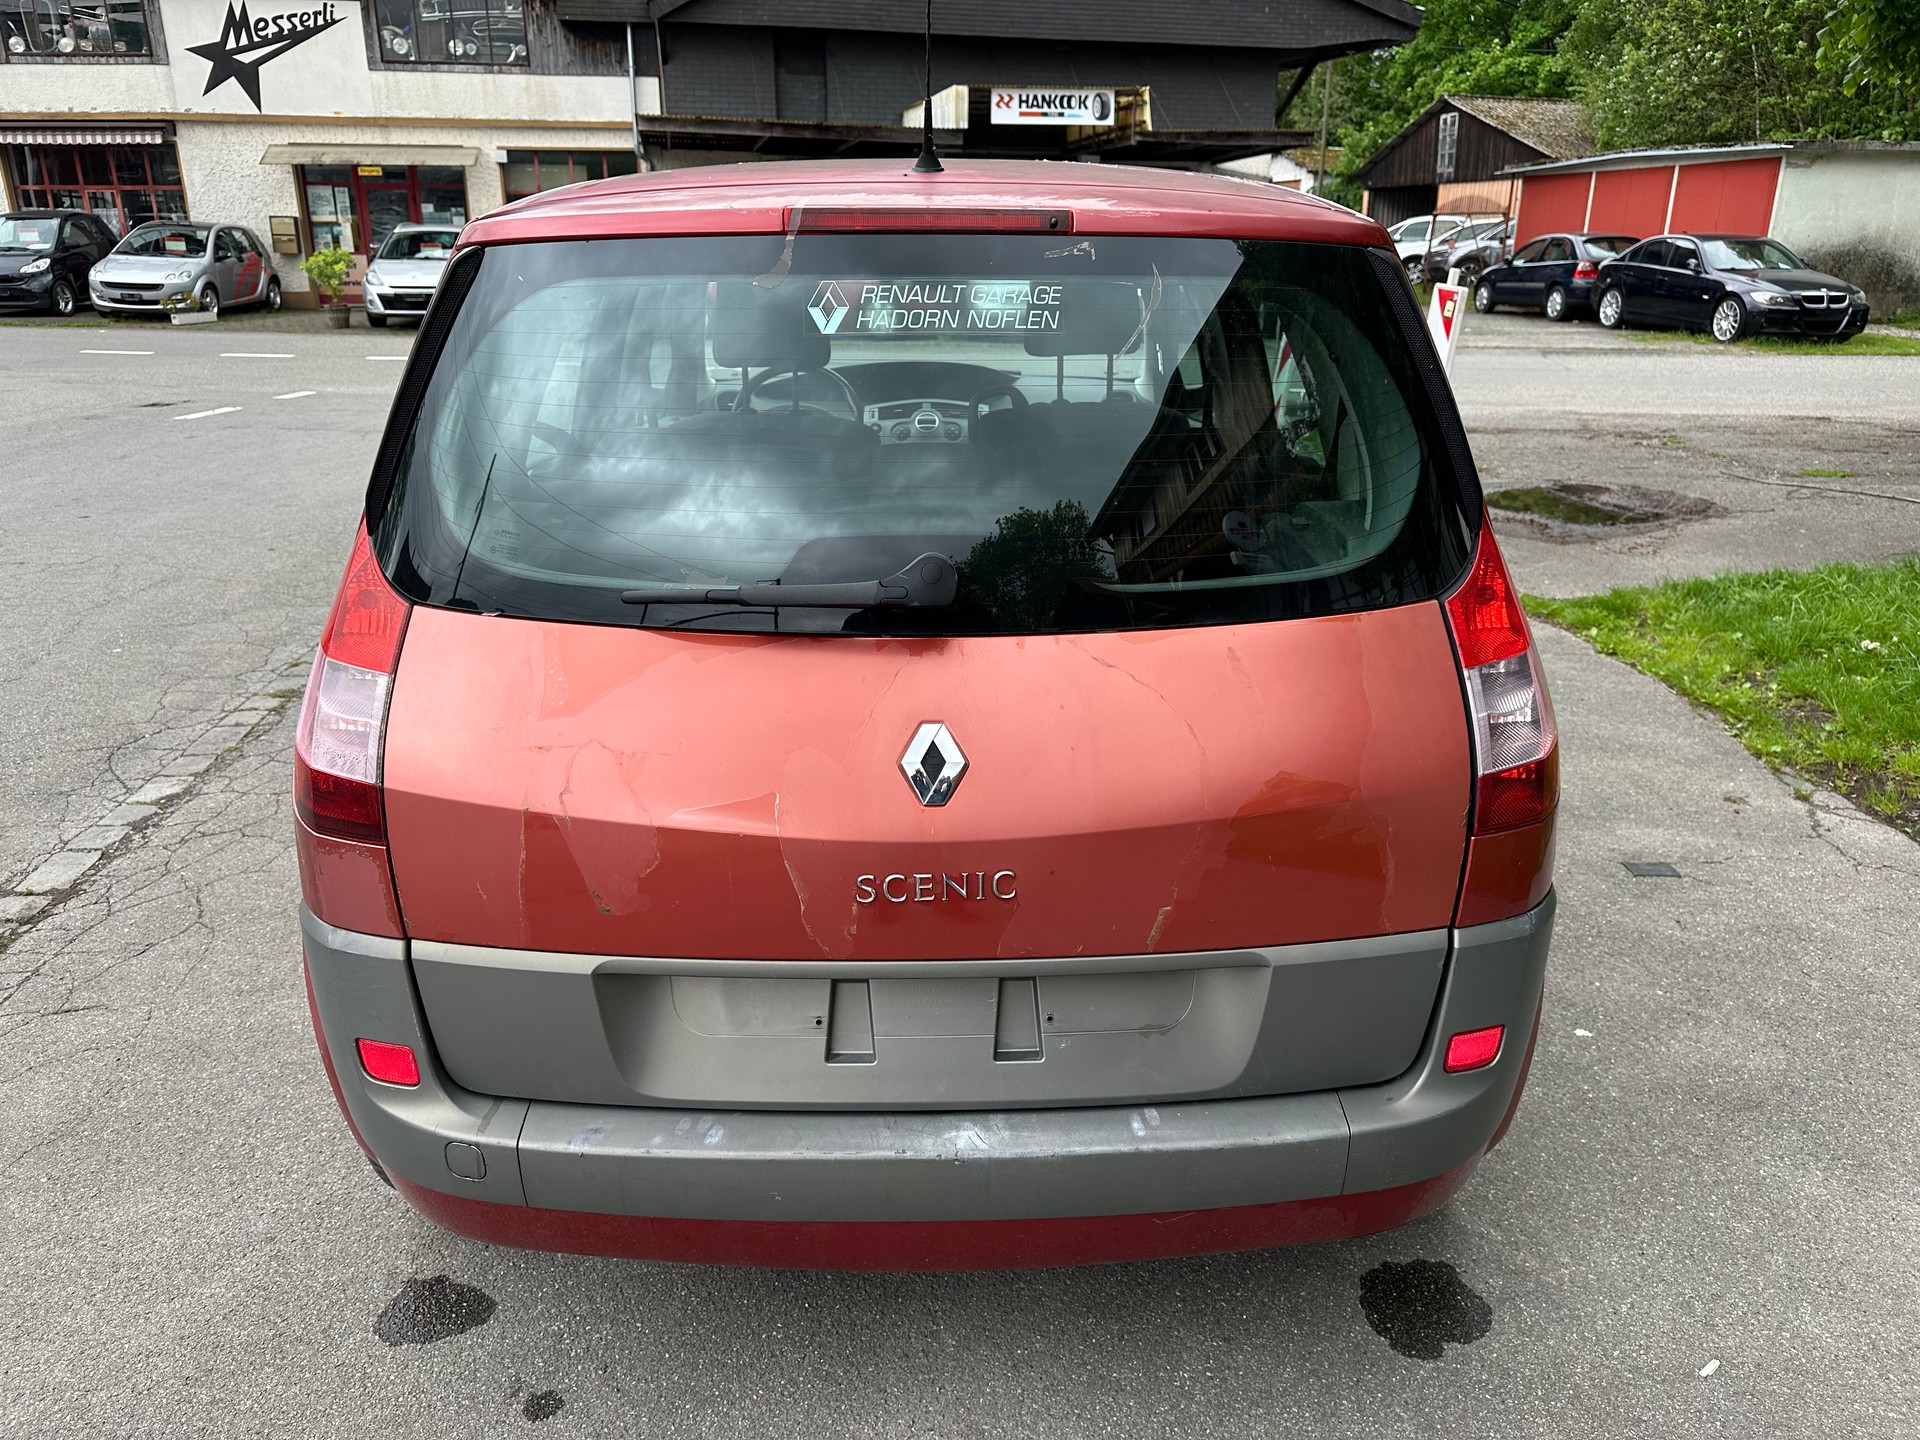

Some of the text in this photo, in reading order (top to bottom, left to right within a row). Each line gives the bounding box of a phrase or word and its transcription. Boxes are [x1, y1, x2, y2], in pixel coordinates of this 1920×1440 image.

[218, 0, 337, 50] Messerli
[1018, 94, 1089, 109] HANKOOK
[860, 284, 1063, 305] RENAULT GARAGE
[856, 309, 1060, 329] HADORN NOFLEN
[856, 870, 1017, 904] SCENIC
